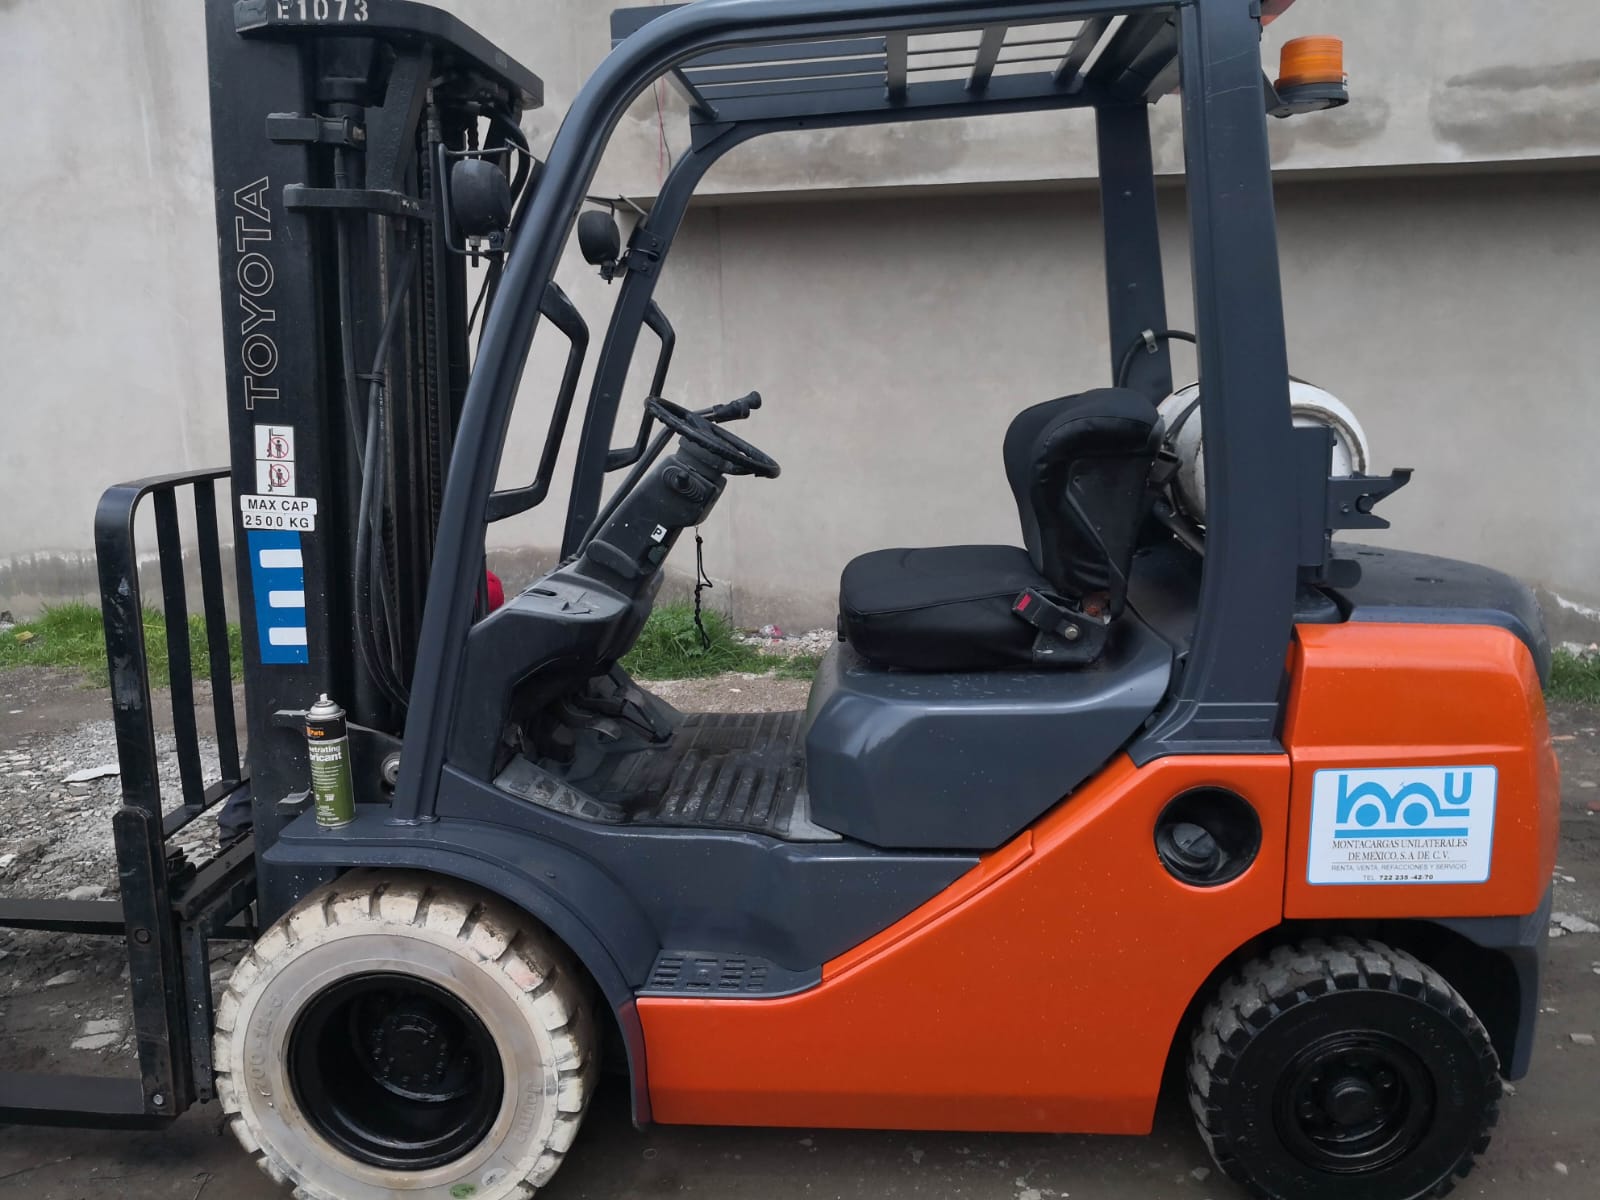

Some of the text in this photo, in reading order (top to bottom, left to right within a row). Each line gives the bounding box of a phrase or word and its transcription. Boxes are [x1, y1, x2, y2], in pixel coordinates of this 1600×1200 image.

[277, 0, 369, 21] E1073
[234, 176, 280, 410] TOYOTA
[248, 499, 309, 512] MAX CAP
[245, 515, 309, 528] 2500 KG
[1332, 838, 1468, 849] MONTACARGAS UNILATERALES
[1348, 851, 1360, 861] DE
[1417, 850, 1430, 860] DE
